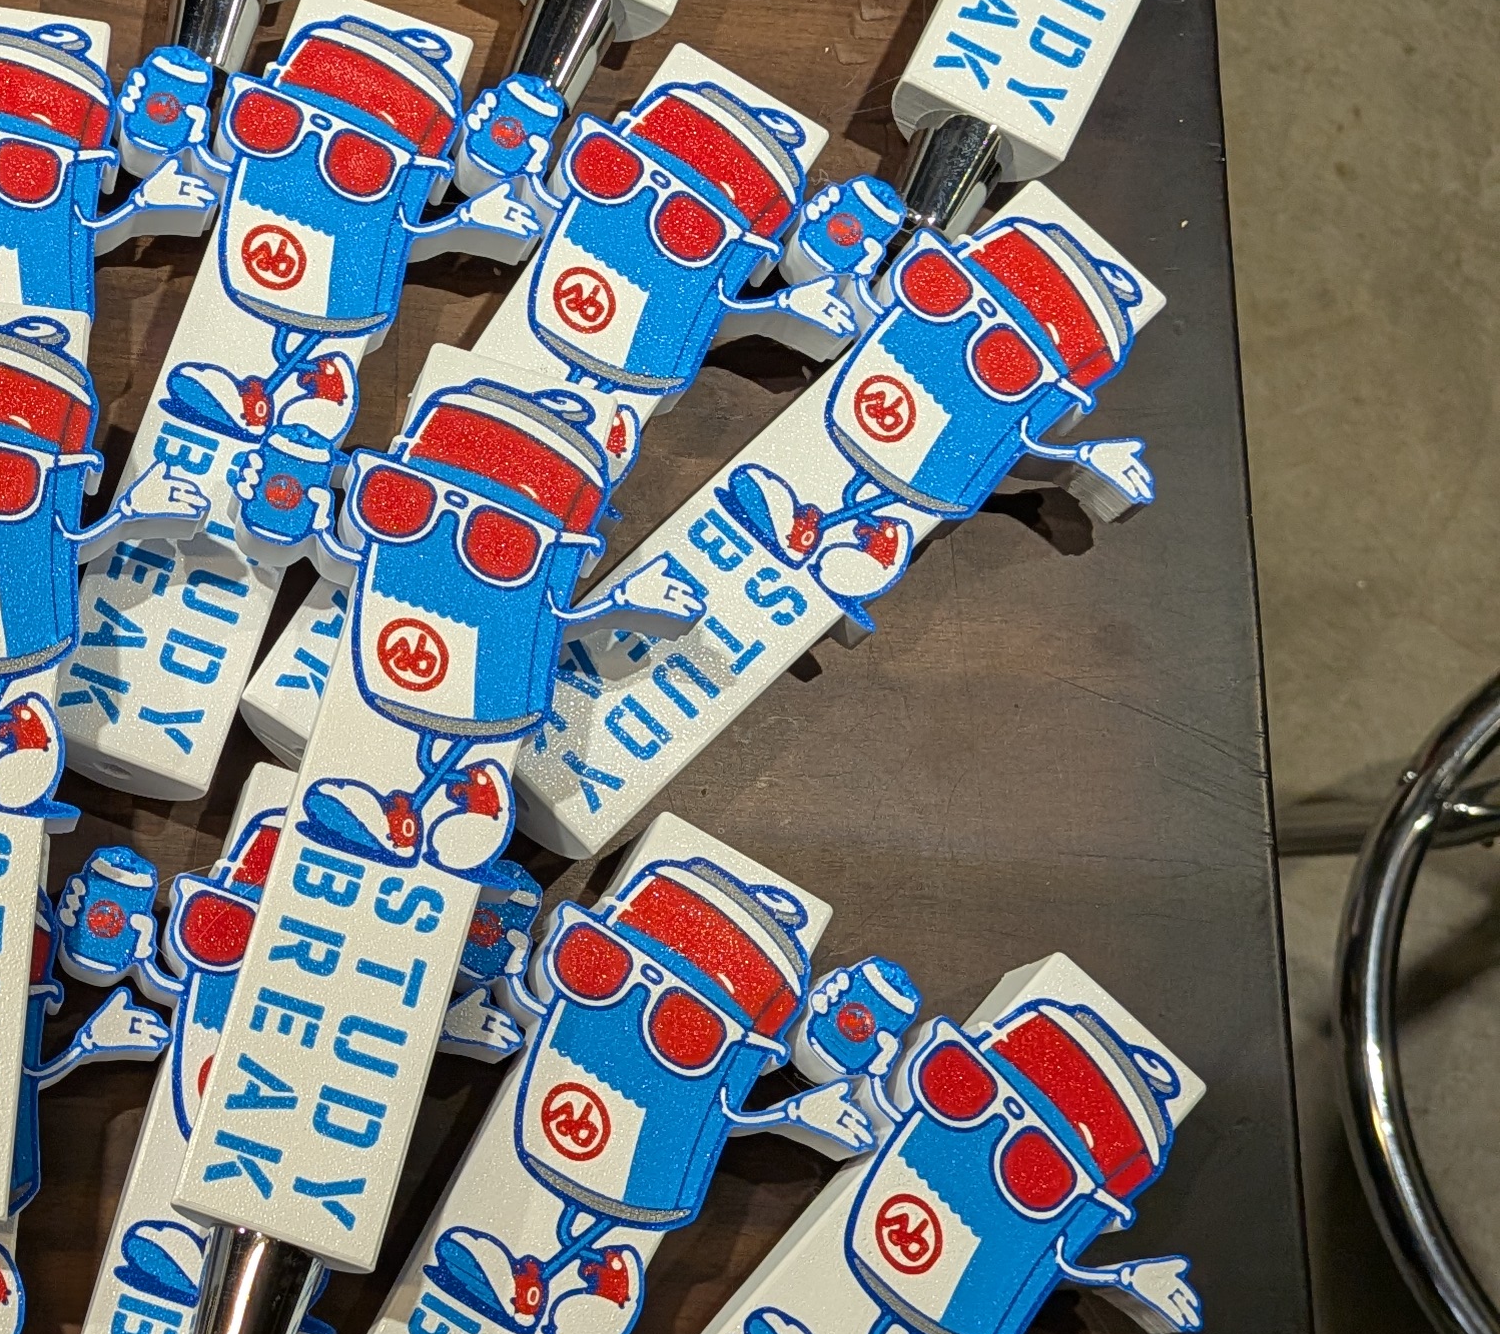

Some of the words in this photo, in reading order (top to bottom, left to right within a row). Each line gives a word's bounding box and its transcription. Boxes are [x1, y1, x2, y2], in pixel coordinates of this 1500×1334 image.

[57, 421, 220, 725] BEAK
[561, 566, 808, 814] STUDY
[203, 846, 365, 1201] BREAK
[292, 876, 440, 1231] STUDY
